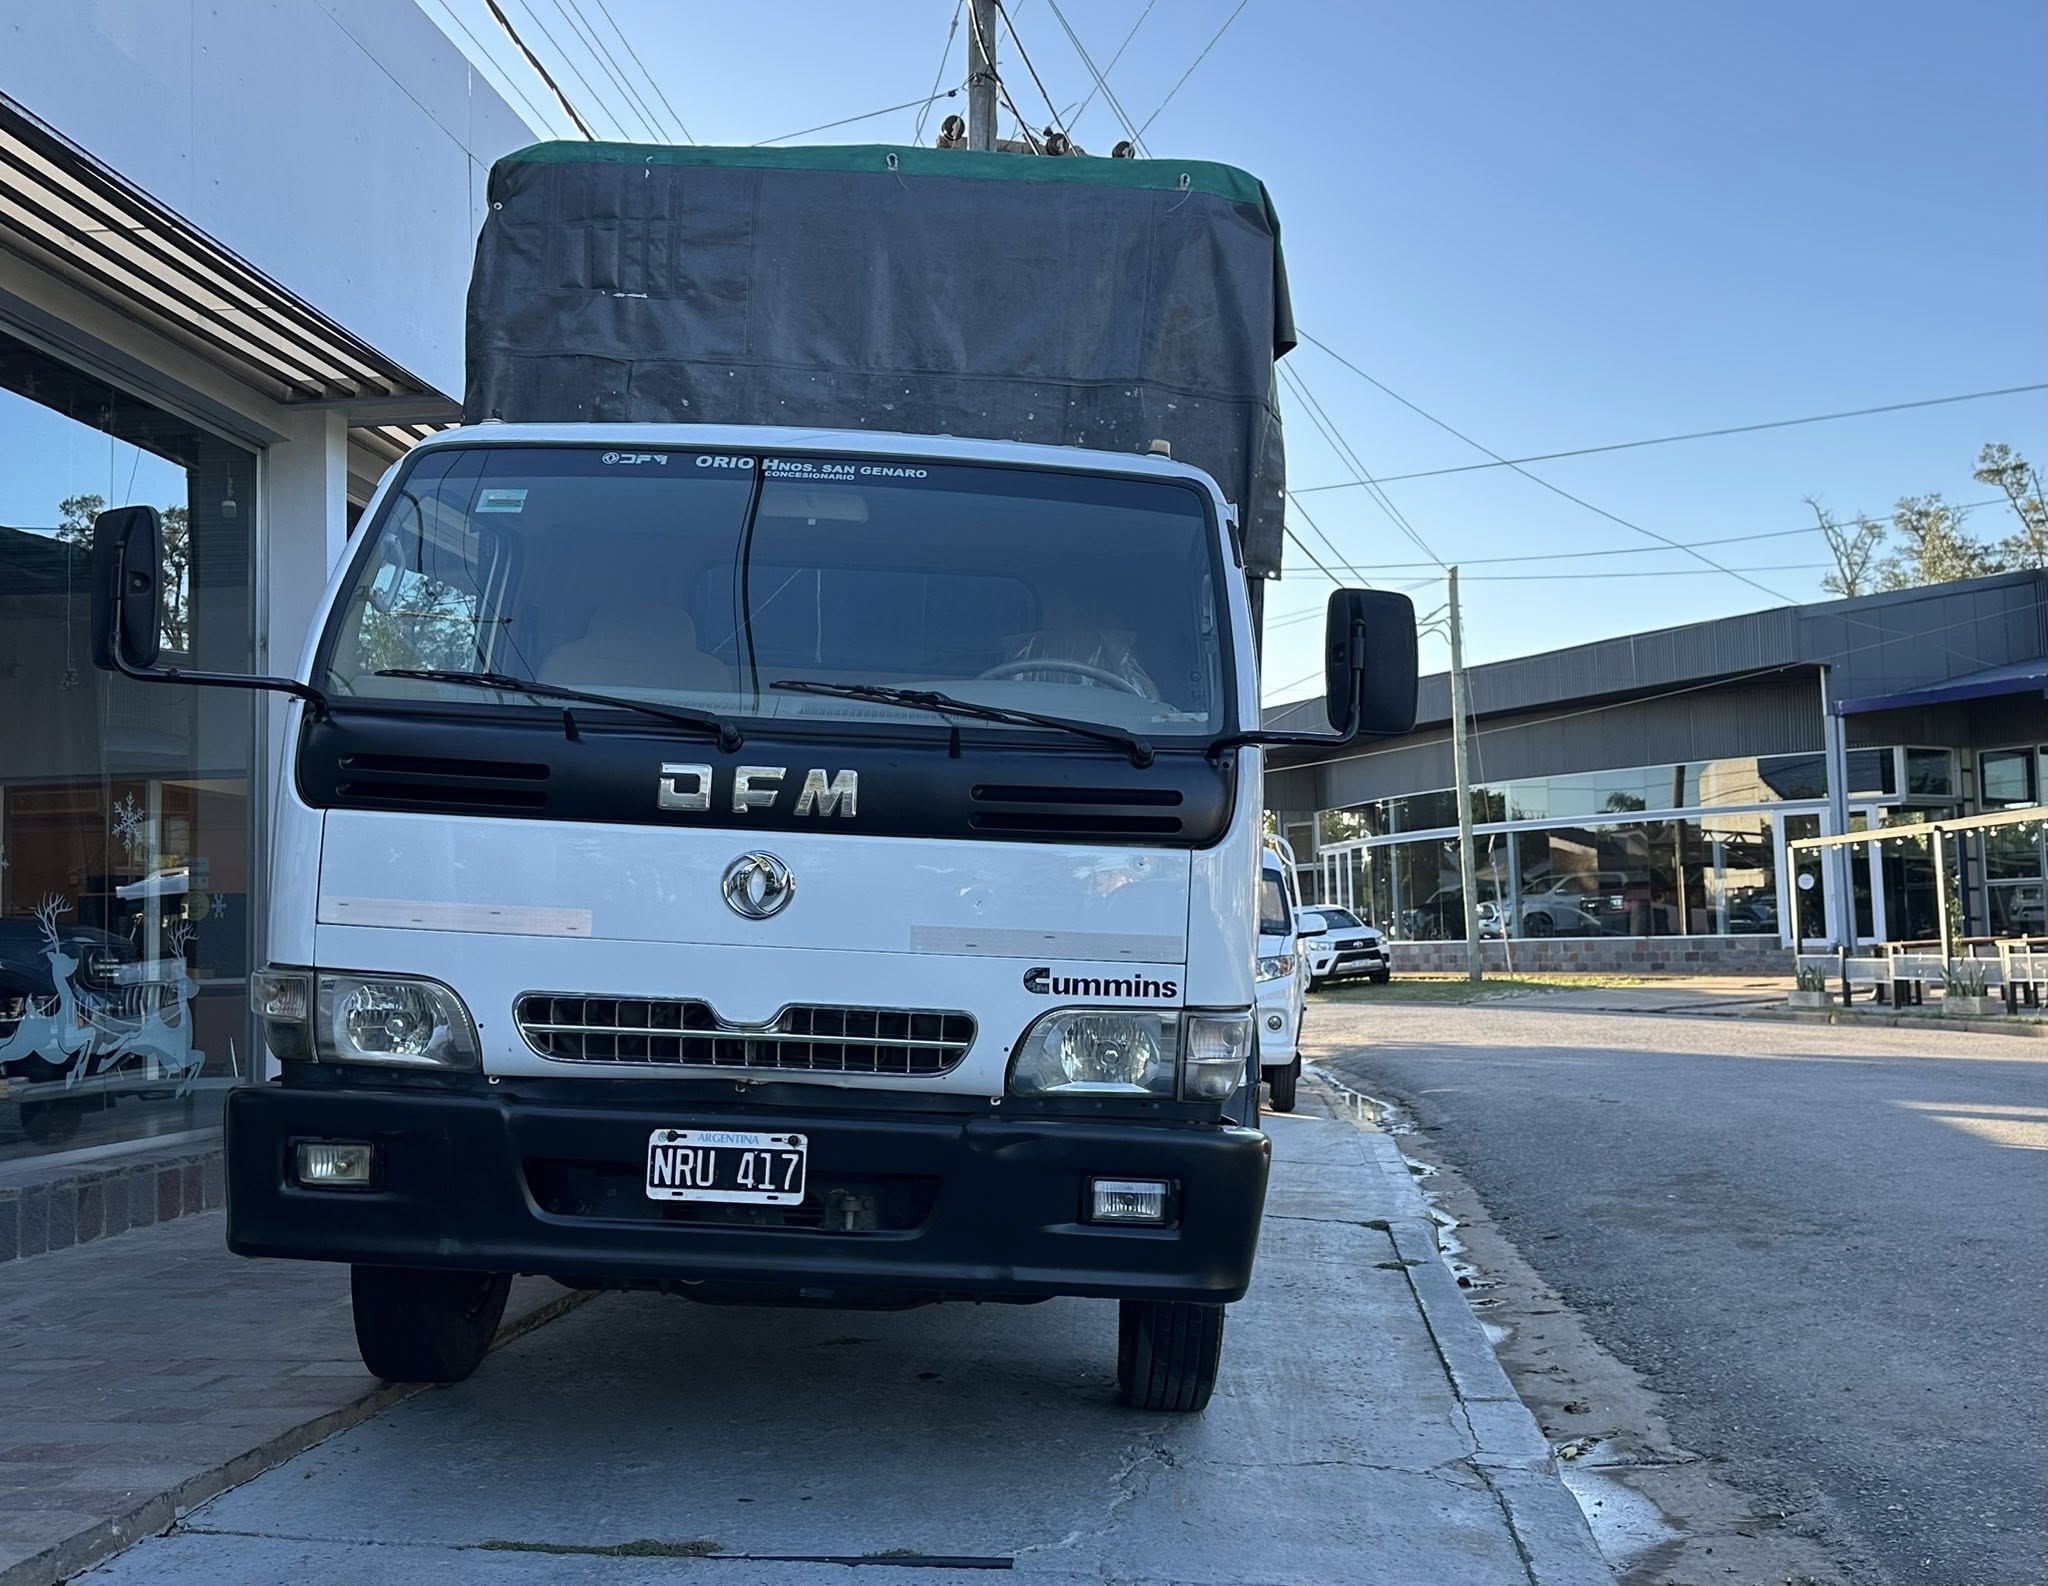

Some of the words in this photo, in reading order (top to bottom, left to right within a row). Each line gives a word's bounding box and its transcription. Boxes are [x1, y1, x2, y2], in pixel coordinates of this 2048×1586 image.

[764, 470, 855, 481] CONCESIONARIO
[822, 464, 855, 474] SAN
[860, 466, 928, 478] GENARO
[657, 761, 859, 818] DFM
[1023, 966, 1178, 998] Cummins
[697, 1132, 760, 1145] ARGENTINA
[653, 1147, 716, 1187] NRU
[736, 1150, 800, 1191] 417
